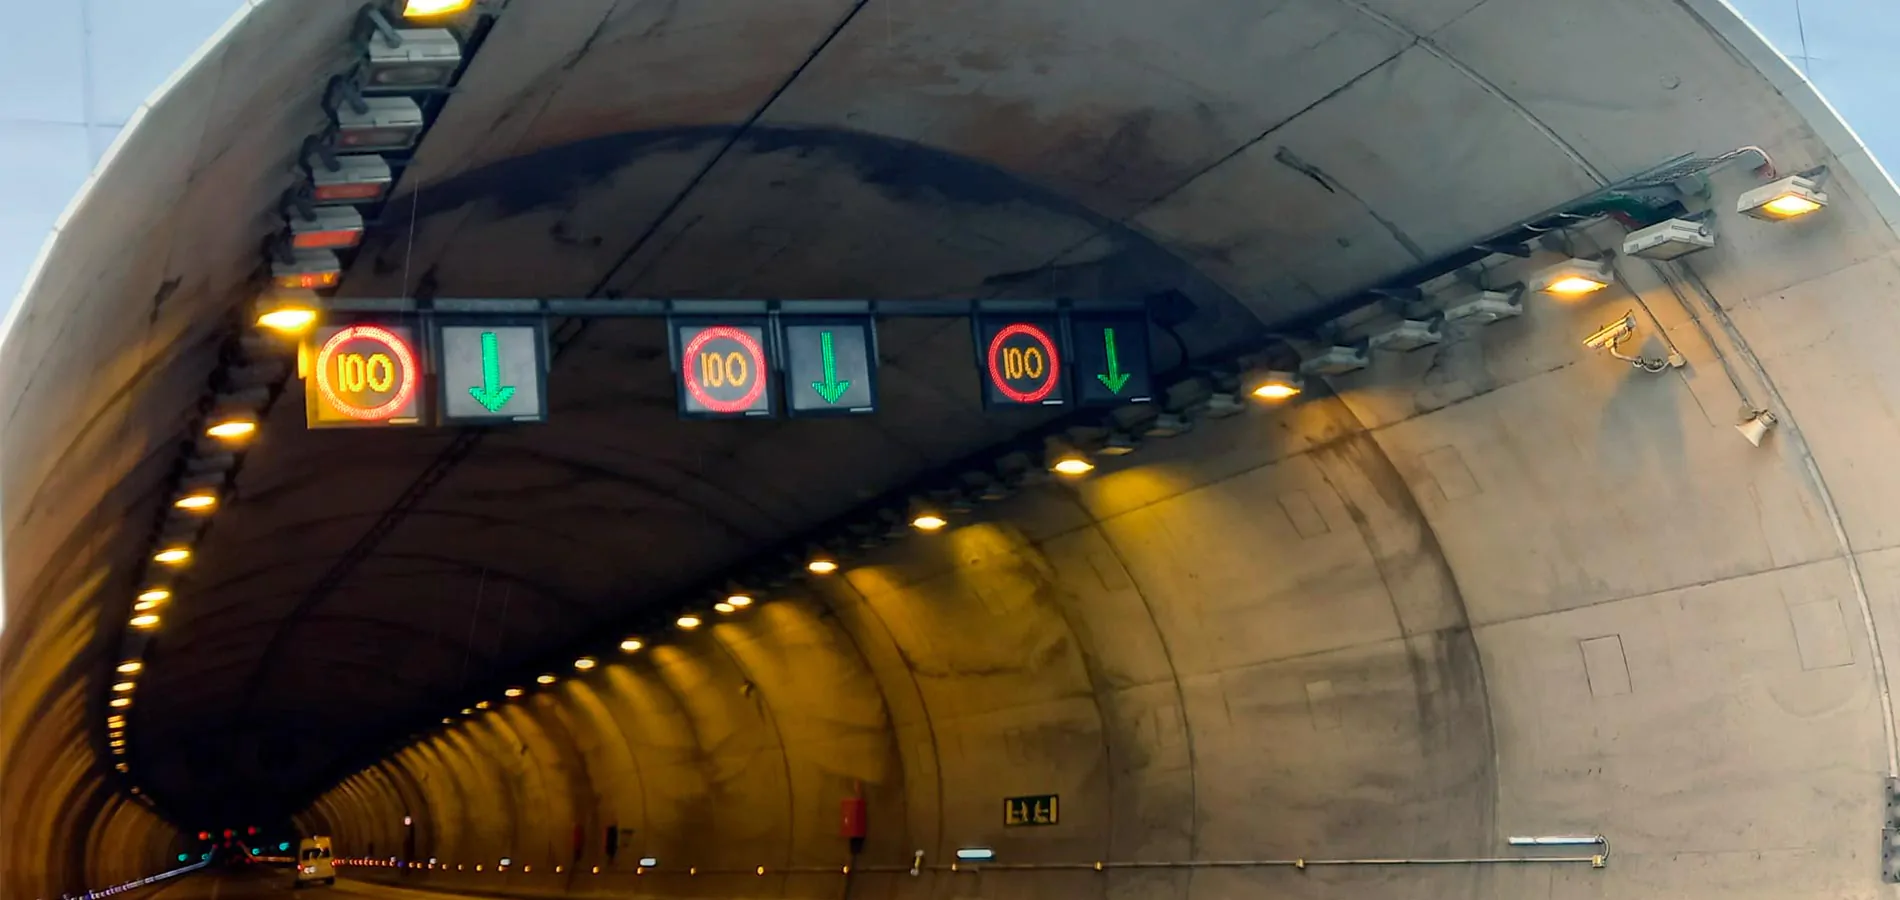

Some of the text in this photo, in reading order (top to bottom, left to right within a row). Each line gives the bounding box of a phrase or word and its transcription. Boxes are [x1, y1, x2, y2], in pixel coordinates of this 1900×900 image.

[338, 354, 393, 391] 100
[701, 352, 747, 387] 100
[1002, 347, 1042, 379] 100
